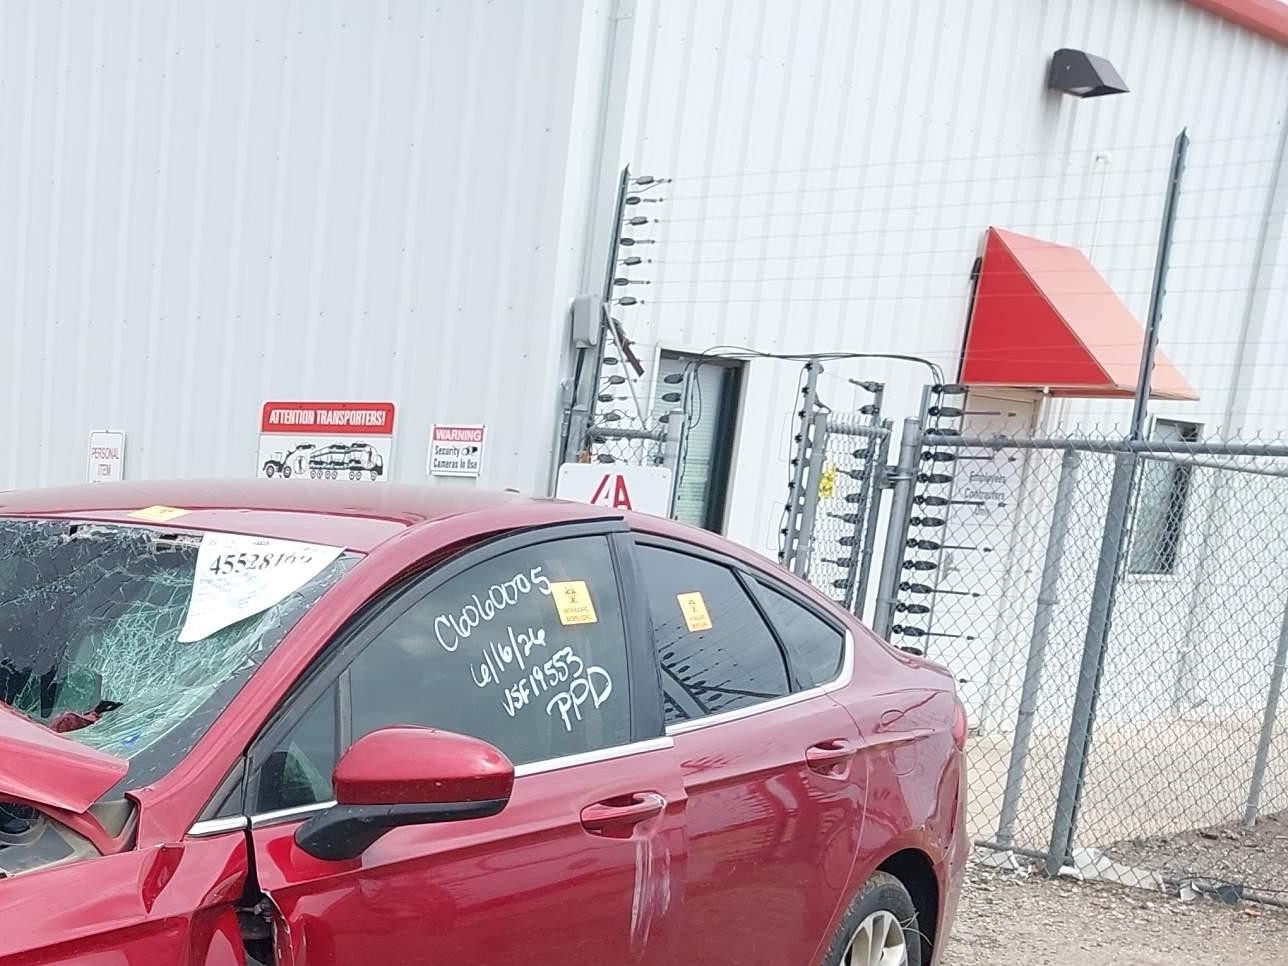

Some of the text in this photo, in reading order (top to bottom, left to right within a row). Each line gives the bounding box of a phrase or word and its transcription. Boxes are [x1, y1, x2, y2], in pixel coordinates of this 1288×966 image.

[269, 409, 387, 426] ATTENTION TRANSPORTERS!
[436, 429, 482, 441] WARNING
[91, 447, 120, 460] PERSONAL
[434, 445, 460, 458] Security
[433, 458, 458, 469] Cameras
[434, 567, 552, 651] C6060005
[470, 626, 546, 688] 6/16/26
[546, 666, 612, 731] PPD
